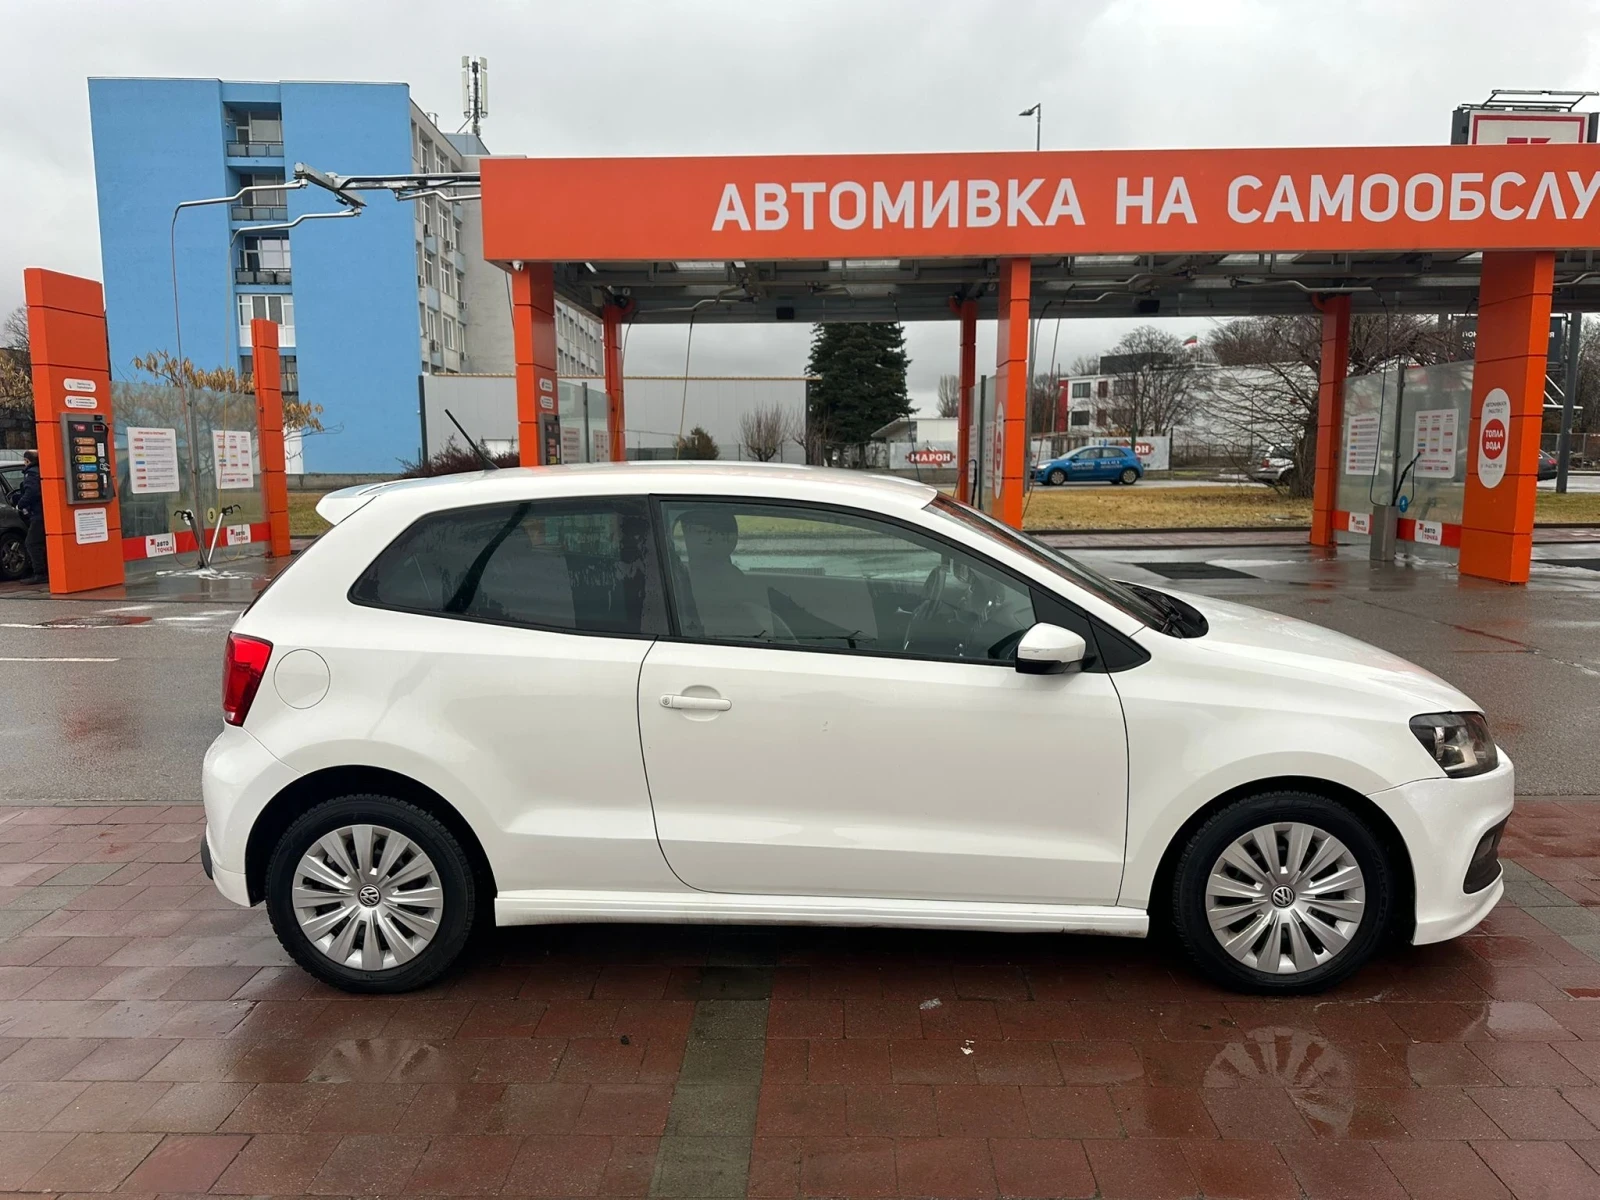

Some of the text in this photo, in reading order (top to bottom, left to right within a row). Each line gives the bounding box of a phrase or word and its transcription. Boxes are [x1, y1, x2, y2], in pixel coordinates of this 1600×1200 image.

[711, 177, 1086, 231] АВТОМИВКА
[1115, 175, 1198, 225] НА
[1485, 430, 1503, 438] ТОПЛА
[1485, 441, 1501, 451] ВОДА
